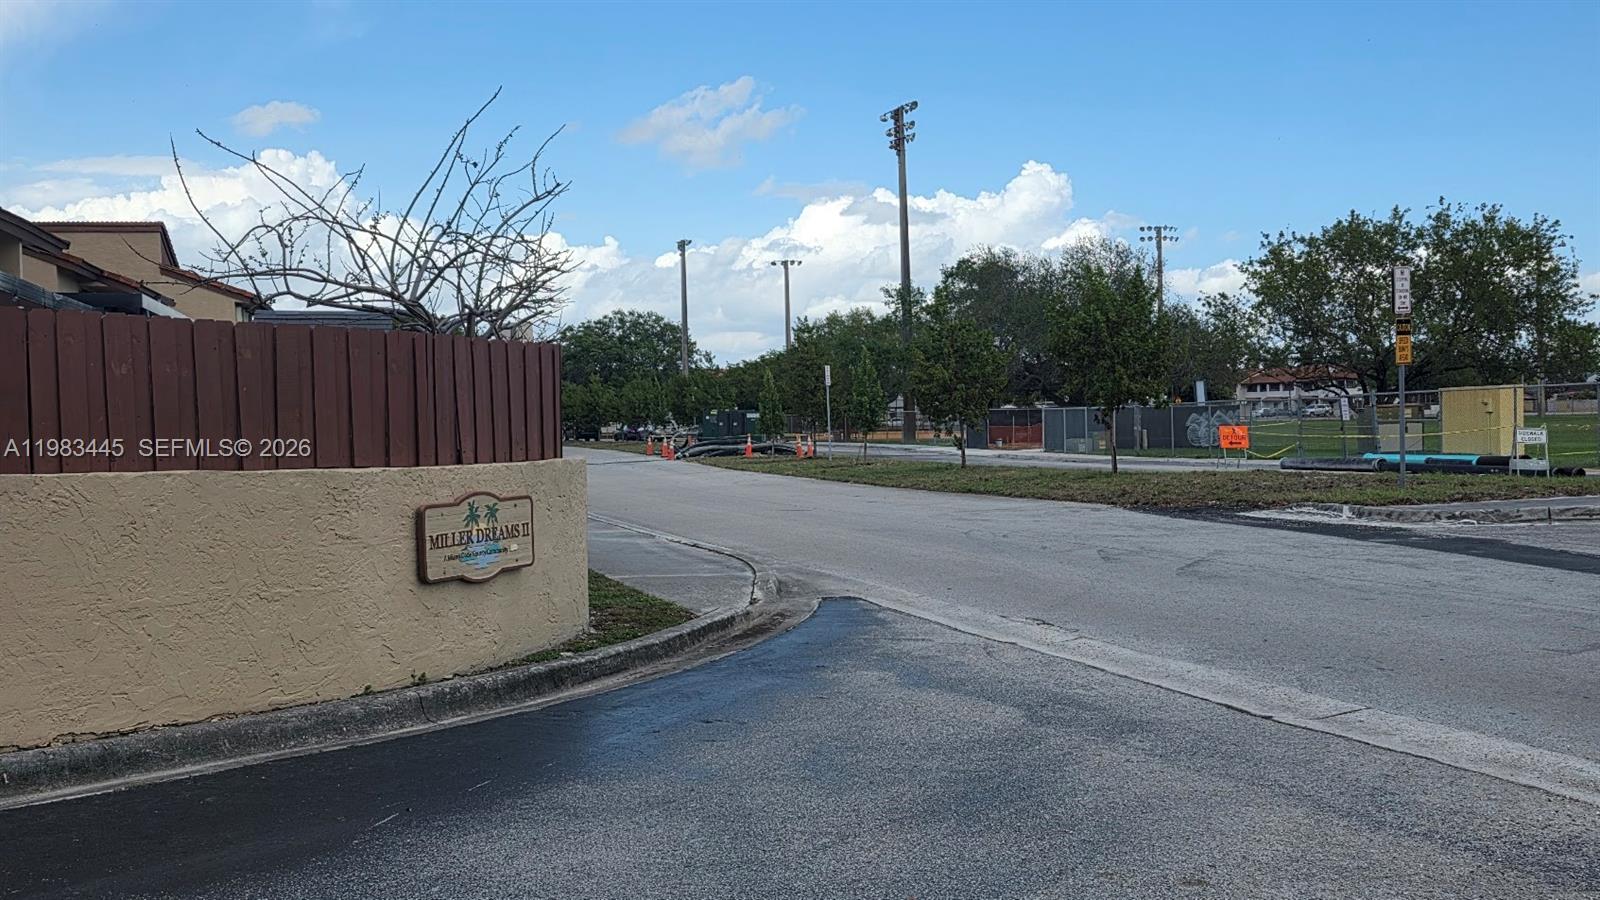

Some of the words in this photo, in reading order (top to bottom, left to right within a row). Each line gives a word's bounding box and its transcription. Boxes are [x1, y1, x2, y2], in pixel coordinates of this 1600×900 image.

[428, 530, 474, 550] MILLER
[475, 523, 520, 544] DREAMS
[521, 522, 530, 537] II
